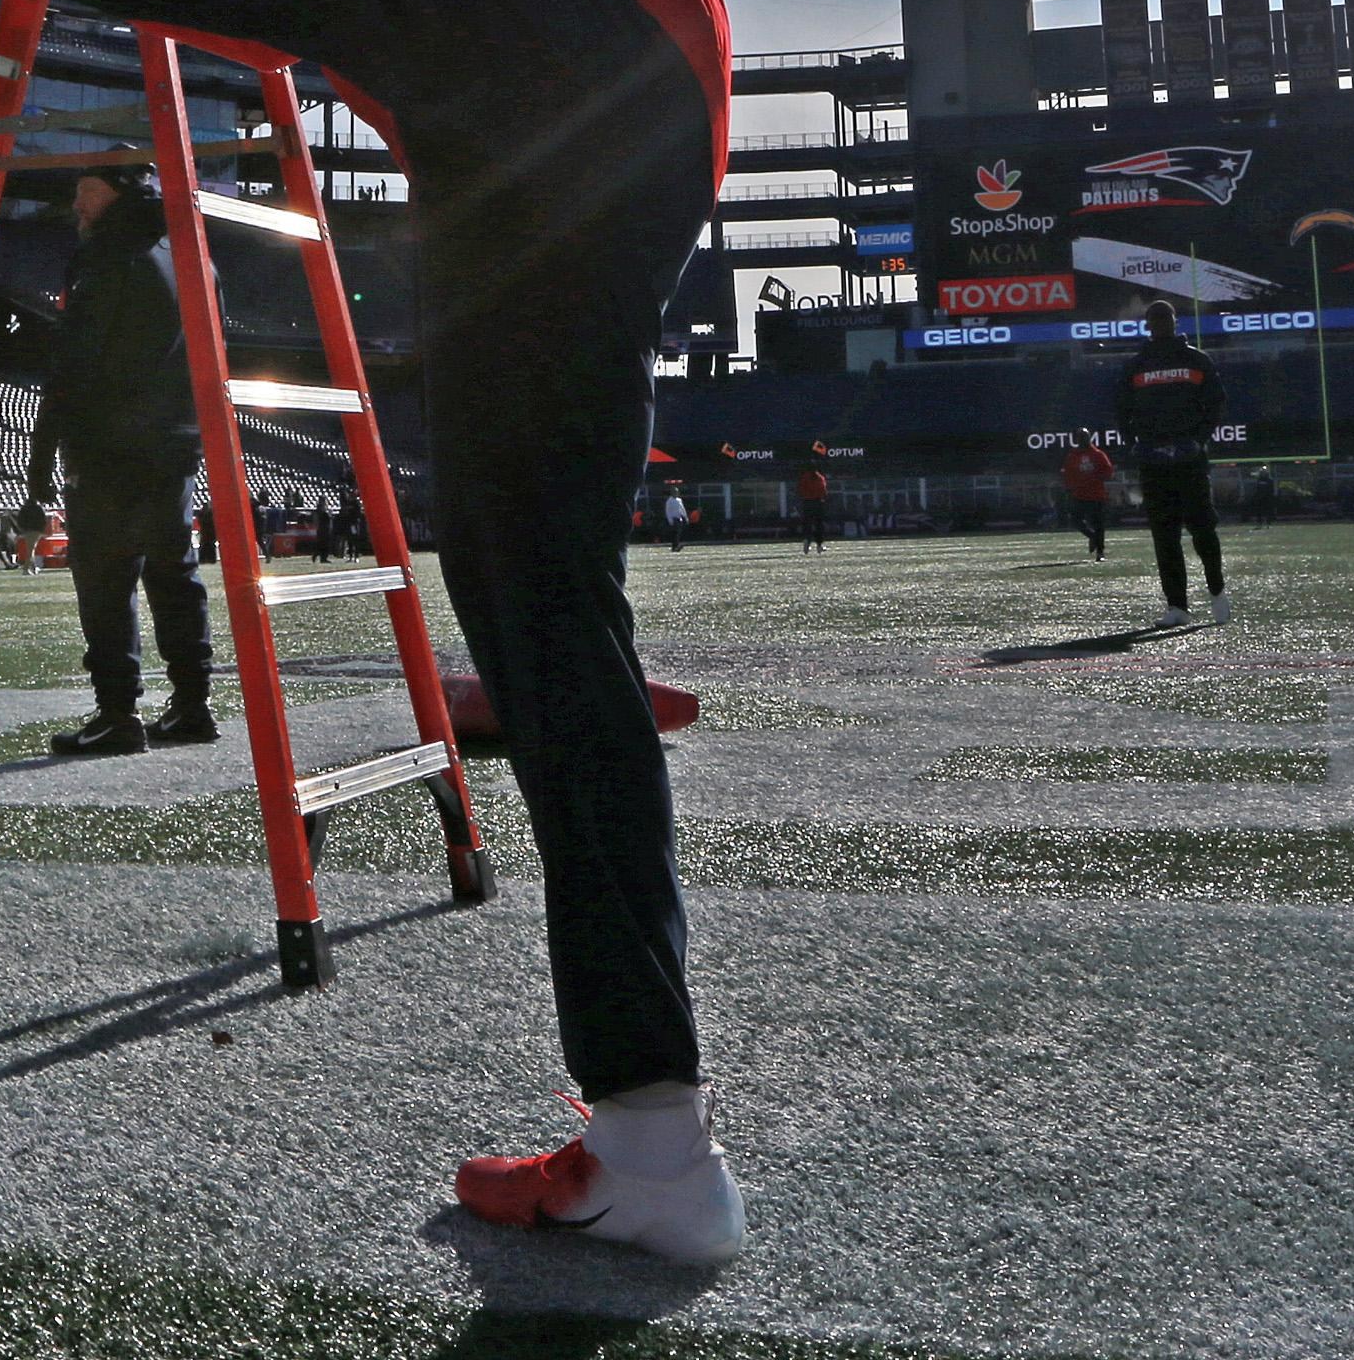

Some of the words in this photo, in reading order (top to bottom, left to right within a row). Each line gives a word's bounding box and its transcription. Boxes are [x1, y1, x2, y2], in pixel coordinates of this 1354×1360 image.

[1082, 188, 1158, 206] PATRIOTS
[950, 213, 1054, 237] Stop&Shop
[859, 231, 911, 246] MEMIC
[969, 244, 1037, 265] MGM
[1122, 260, 1184, 279] jetBlue
[943, 279, 1072, 309] TOYOTA
[1070, 319, 1151, 339] GEIC
[1222, 311, 1315, 332] GEICO
[924, 326, 1011, 345] GEICO
[1145, 368, 1190, 382] PATRIOTS
[737, 450, 773, 461] OPTUM
[827, 447, 863, 458] OPTUM
